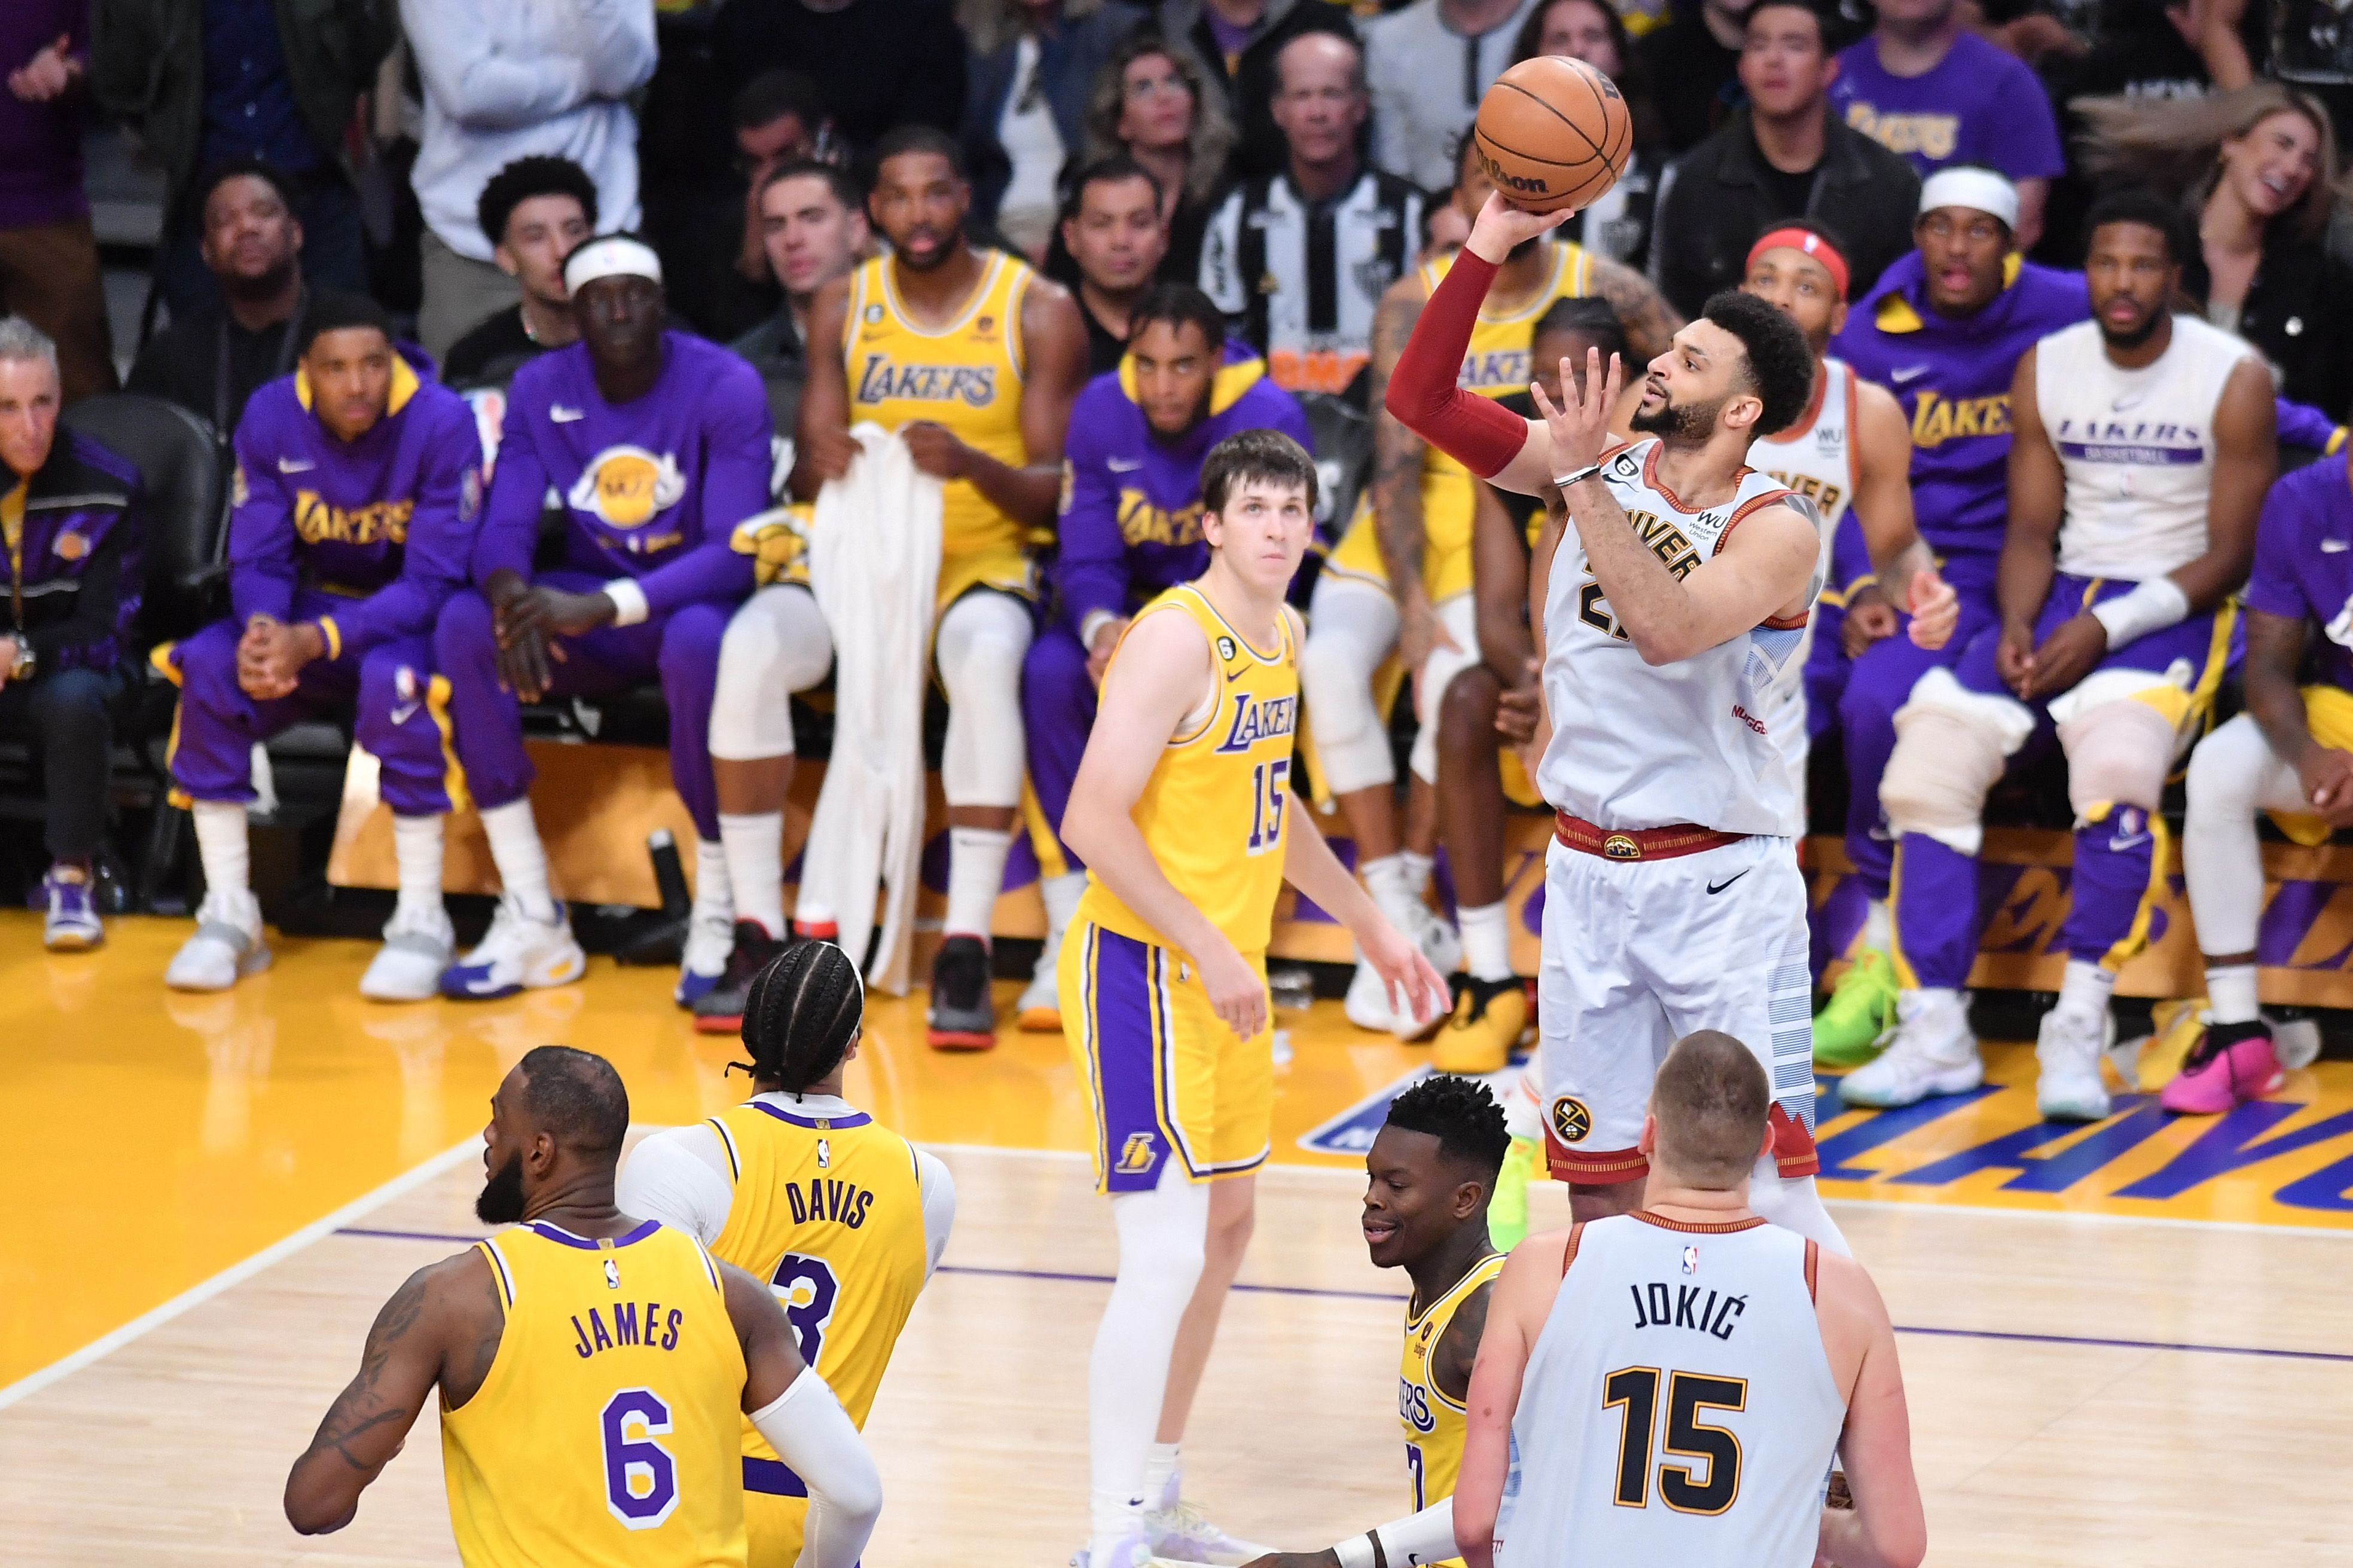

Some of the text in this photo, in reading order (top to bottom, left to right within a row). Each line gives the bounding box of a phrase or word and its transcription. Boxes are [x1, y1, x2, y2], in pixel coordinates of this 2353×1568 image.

[855, 353, 997, 409] LAKERS
[1457, 351, 1530, 387] AKE
[1912, 392, 2011, 448] LAKE
[1116, 488, 1208, 546] LAKE
[1688, 521, 1718, 537] Western
[1688, 529, 1710, 542] Union
[1697, 511, 1728, 529] WU
[1579, 581, 1630, 643] 2
[1217, 636, 1235, 661] 6
[1214, 693, 1296, 754] LAKE
[1247, 757, 1292, 856] 15
[785, 1178, 874, 1230] DAVIS
[571, 1302, 682, 1358] JAMES
[768, 1251, 841, 1373] 3
[1631, 1283, 1748, 1341] JOKIĆ
[1398, 1375, 1436, 1433] ERS
[599, 1386, 680, 1530] 6
[1601, 1365, 1748, 1517] 15
